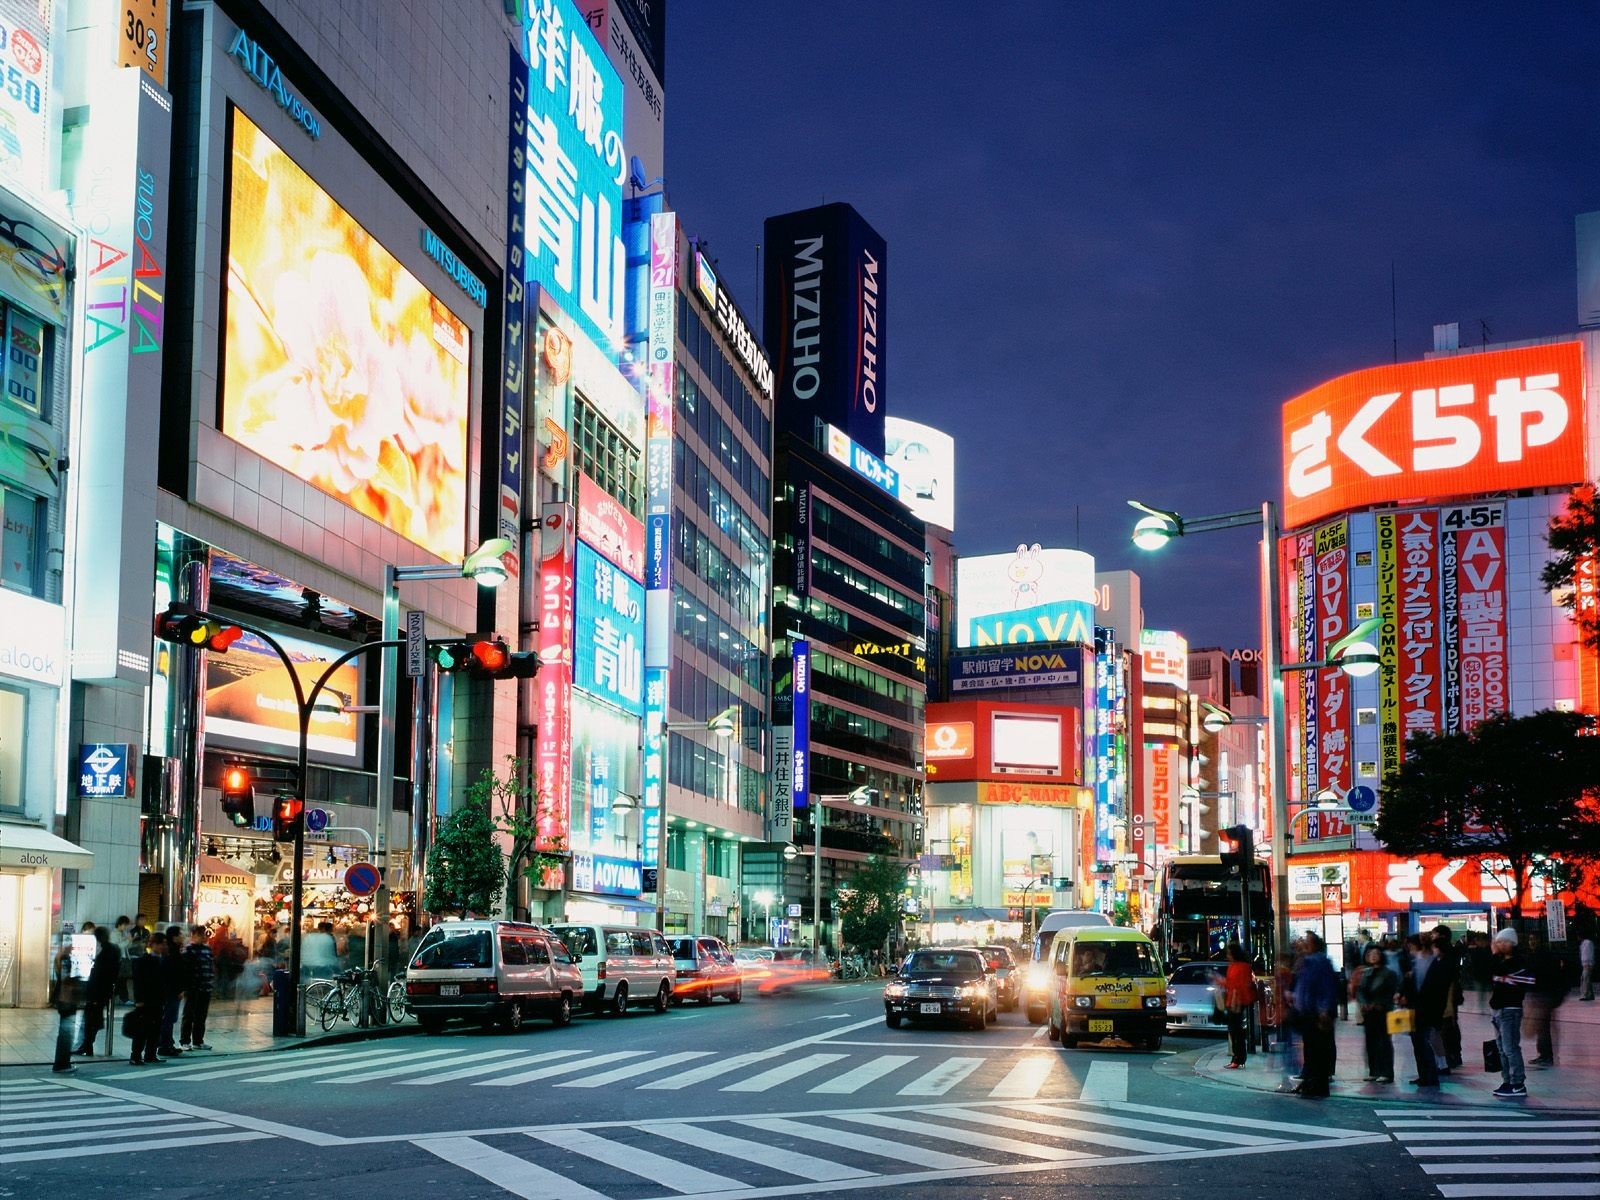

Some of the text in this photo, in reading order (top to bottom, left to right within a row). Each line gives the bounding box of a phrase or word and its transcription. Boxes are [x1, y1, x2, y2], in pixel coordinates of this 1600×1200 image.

[527, 0, 628, 186] 洋服の
[611, 17, 662, 122] 三井住友銀行
[137, 167, 155, 241] STUDIO
[524, 104, 627, 346] 青山
[132, 237, 163, 355] ALTA
[425, 231, 488, 309] MITSUBISHI
[717, 287, 774, 400] 三井住友VISA
[793, 235, 824, 400] MIZUHO
[863, 248, 879, 414] MIZUHO
[1289, 373, 1568, 498] さくらや
[855, 447, 895, 490] UCカード
[799, 489, 807, 524] MIZUHO
[1298, 534, 1313, 557] 2F
[543, 574, 561, 629] アコム
[595, 558, 641, 624] 洋服の
[1460, 531, 1505, 655] AV製品
[1580, 545, 1594, 610] くらや
[410, 614, 423, 674] スクランブル交差点
[592, 616, 641, 700] 青山
[977, 610, 1091, 648] NOVA
[0, 645, 55, 676] alook
[797, 655, 806, 693] MIZUHO
[962, 654, 1067, 675] 駅前留学 NOVA
[1321, 572, 1348, 836] DVDコーダー続々入!!
[81, 773, 122, 787] 地下鉄
[86, 785, 116, 794] SUBWAY
[592, 756, 610, 809] 青山
[774, 736, 790, 828] 三井住友銀行
[985, 784, 1071, 804] ABC-MART
[20, 853, 48, 865] alook
[224, 875, 248, 885] DOLL
[282, 868, 337, 880] CATAIN
[594, 861, 641, 890] AOYAMA
